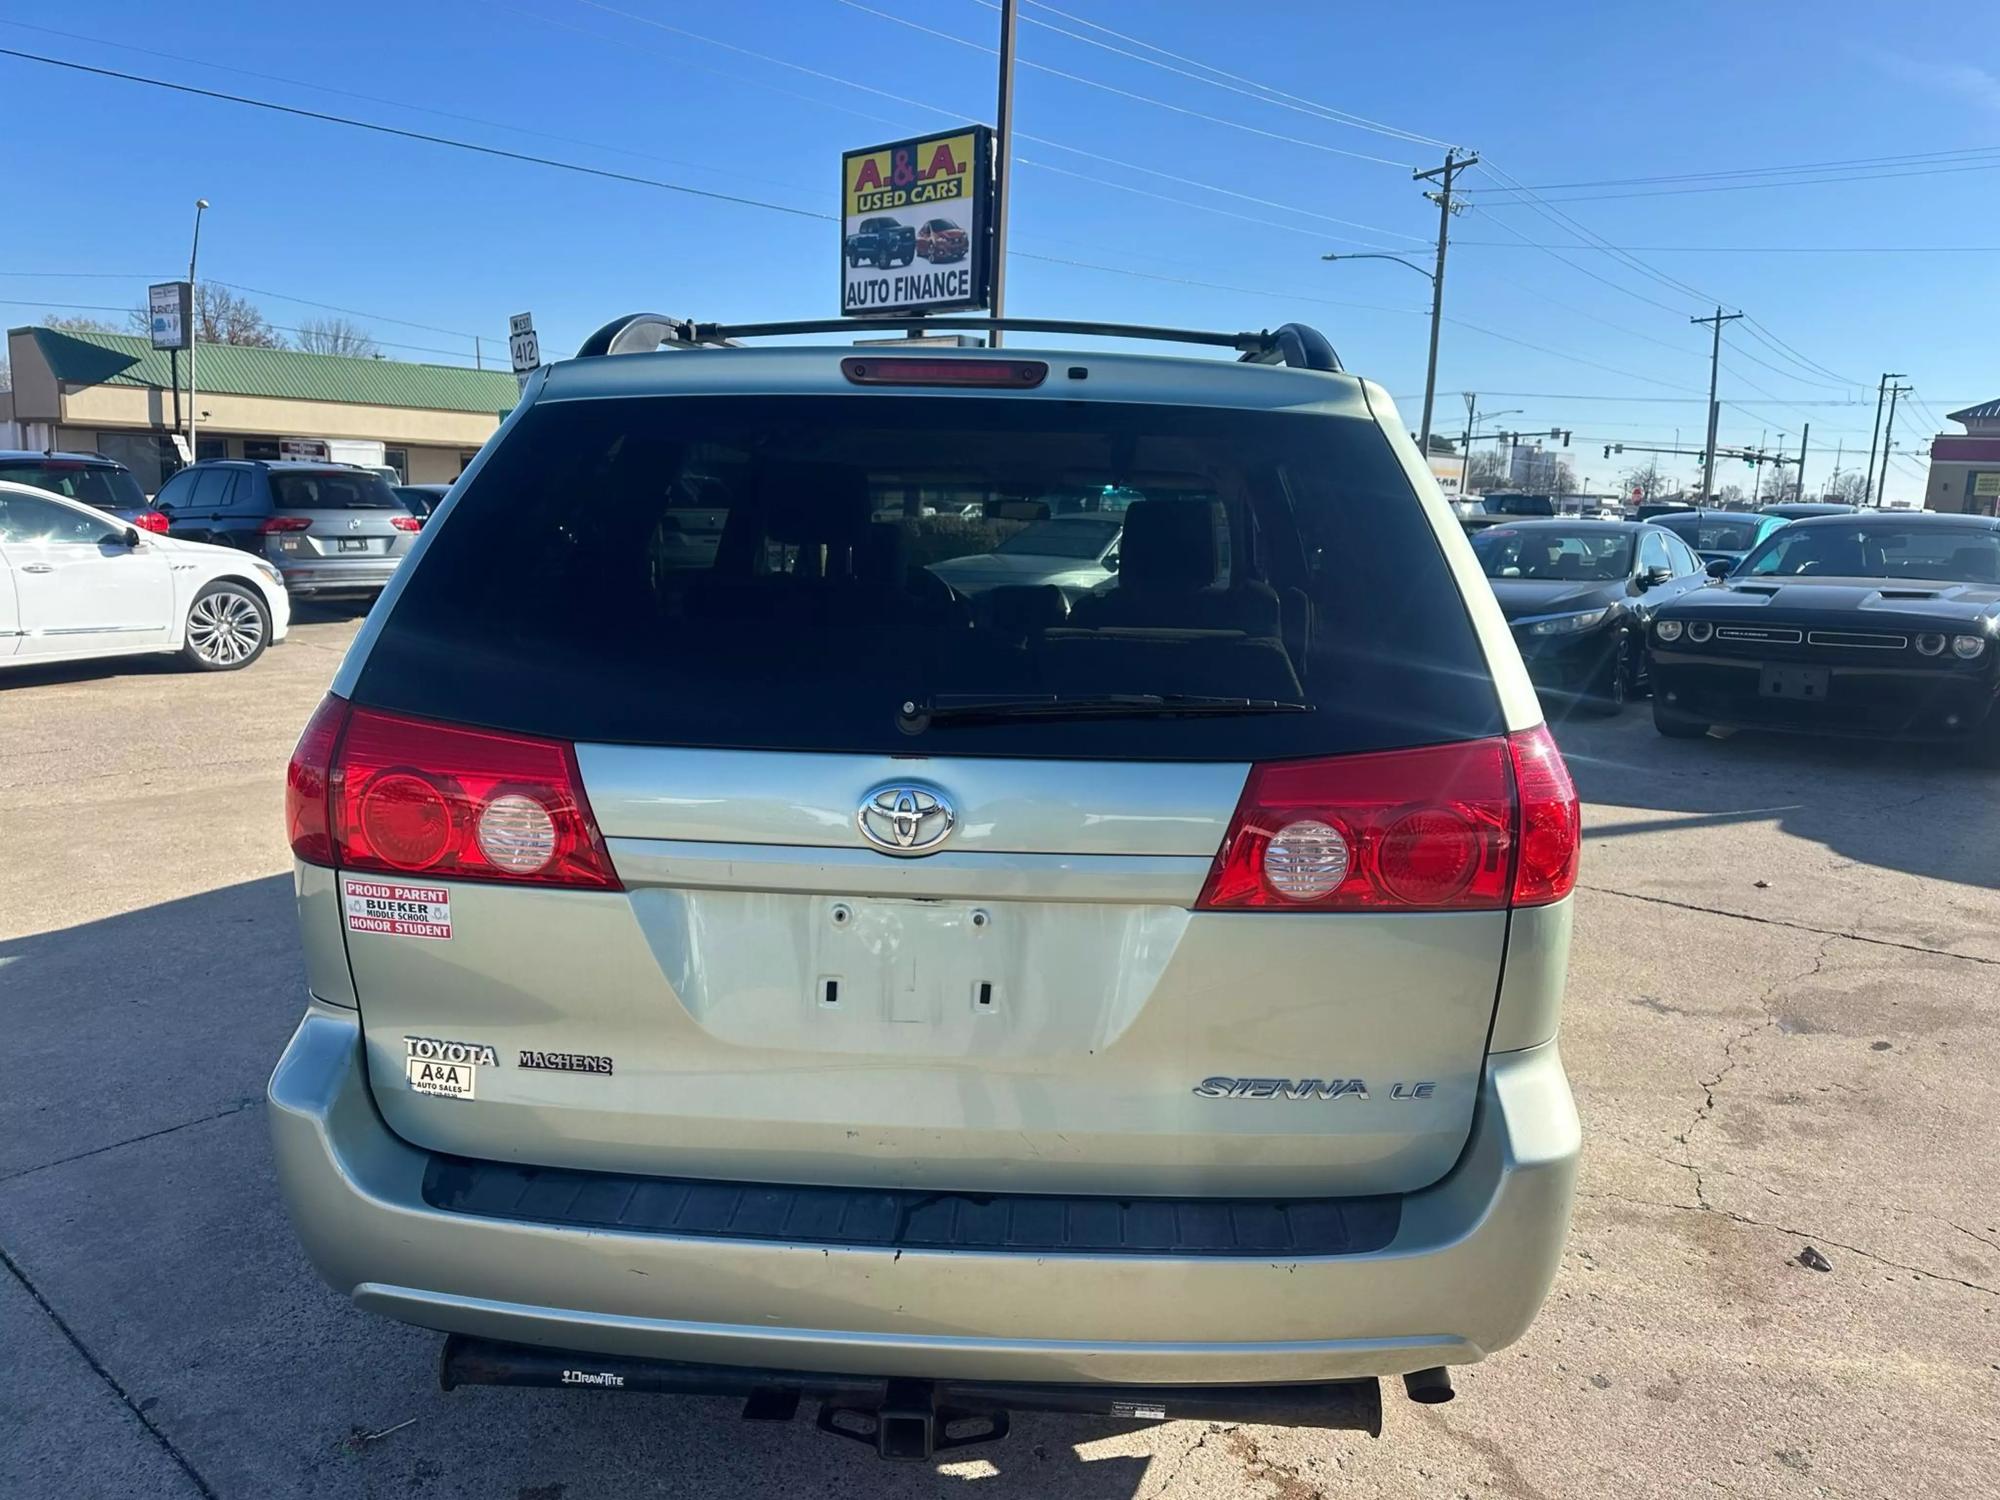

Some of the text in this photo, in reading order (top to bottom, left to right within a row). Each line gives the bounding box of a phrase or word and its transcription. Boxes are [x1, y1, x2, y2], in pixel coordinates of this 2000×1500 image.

[859, 181, 958, 211] USED CARS
[847, 269, 969, 306] AUTO FINANCE
[512, 317, 530, 331] WEST
[515, 340, 536, 363] 412
[347, 883, 445, 902] PROUD PARENT
[366, 899, 428, 914] BUEKER
[366, 909, 430, 922] MIDDLE SCHOOL
[350, 917, 449, 937] HONOR STUDENT
[403, 1036, 499, 1067] TOYOTA
[518, 1051, 613, 1074] MACHENS
[420, 1063, 459, 1085] A&A
[416, 1081, 463, 1093] AUTO SALES
[1192, 1076, 1435, 1100] SIENNA LE
